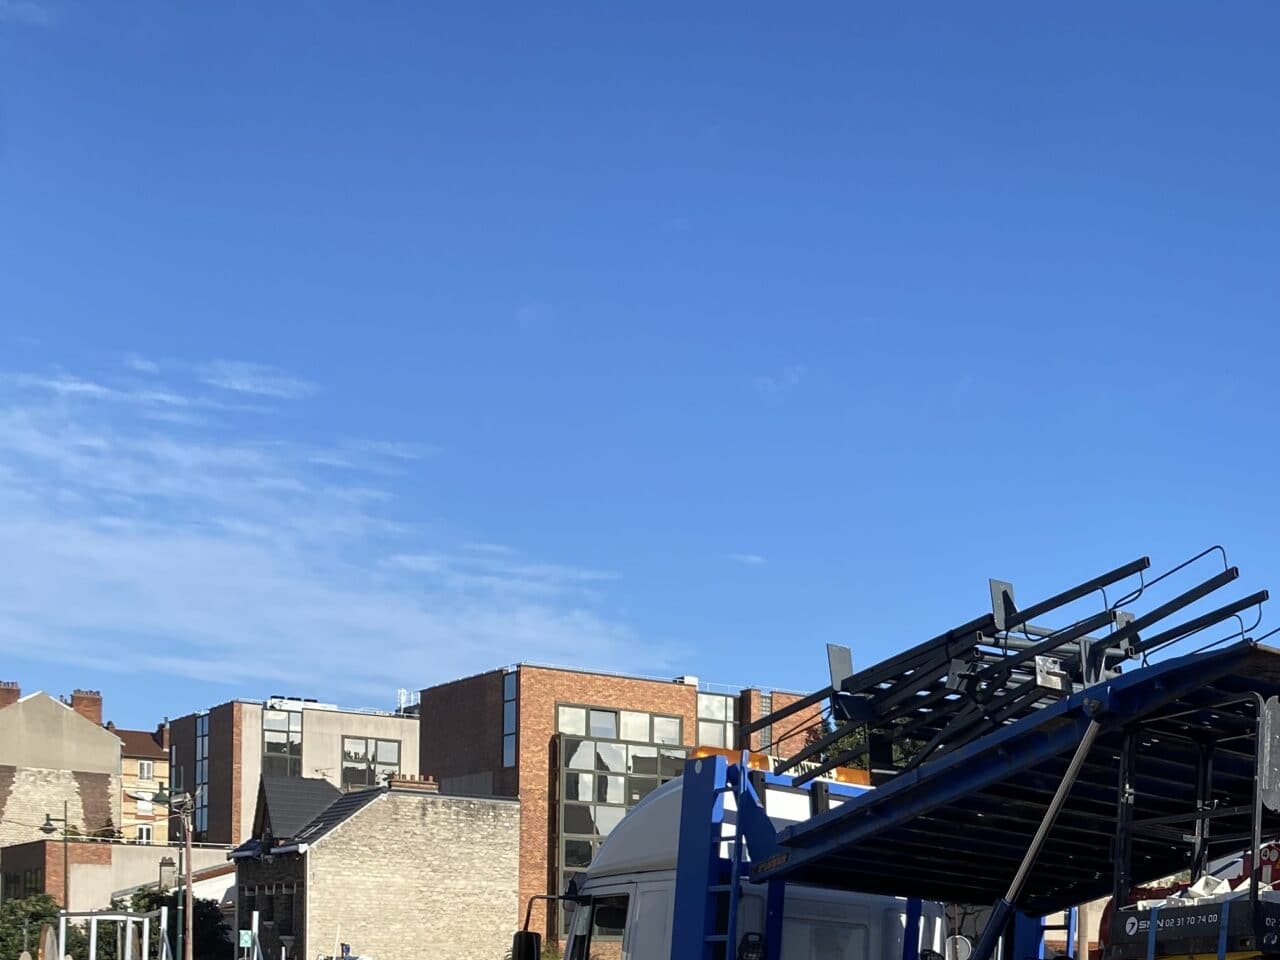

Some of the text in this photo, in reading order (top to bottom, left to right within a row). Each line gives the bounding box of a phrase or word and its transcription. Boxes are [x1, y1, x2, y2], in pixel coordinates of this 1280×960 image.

[1165, 918, 1175, 928] 02
[1176, 917, 1185, 927] 31
[1186, 916, 1196, 925] 70
[1197, 915, 1207, 924] 74
[1208, 914, 1218, 923] 00
[1265, 917, 1277, 927] 02
